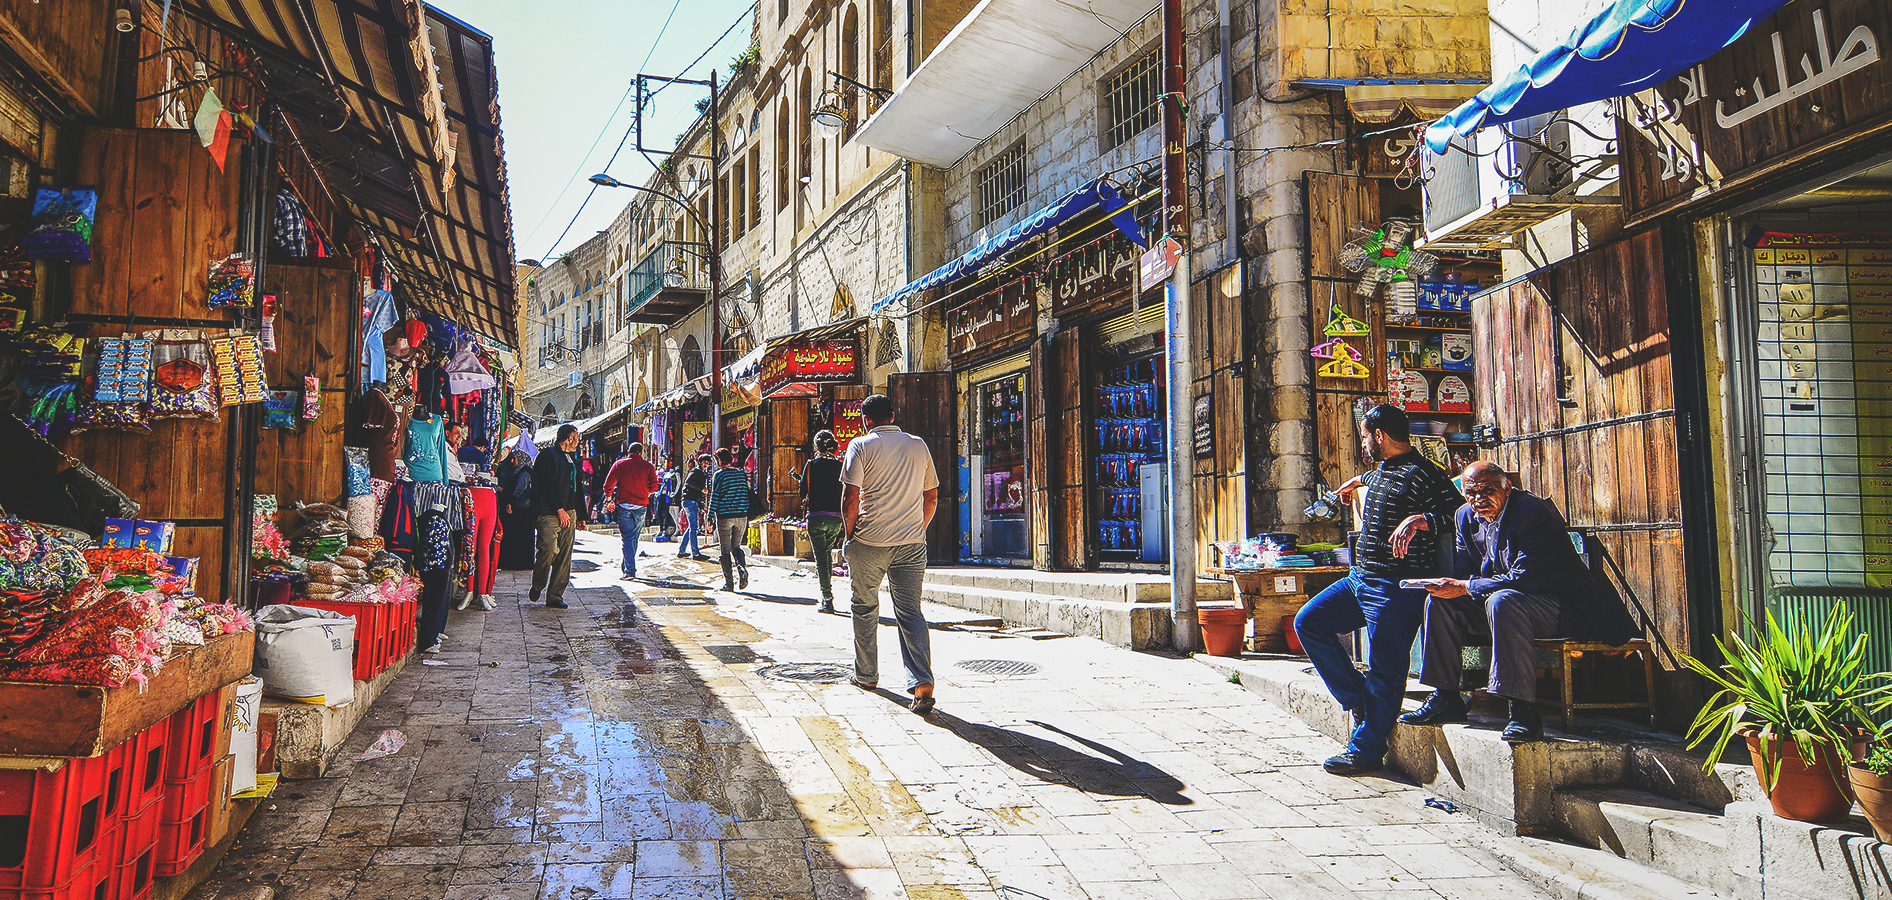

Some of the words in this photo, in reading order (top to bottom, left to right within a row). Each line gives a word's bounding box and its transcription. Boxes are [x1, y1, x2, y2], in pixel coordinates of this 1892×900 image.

[1808, 235, 1840, 244] قائمة
[1779, 251, 1806, 264] دينار
[1816, 251, 1839, 263] فلس
[1790, 289, 1804, 302] ١١
[1011, 296, 1030, 317] عطور
[832, 351, 853, 366] عبود
